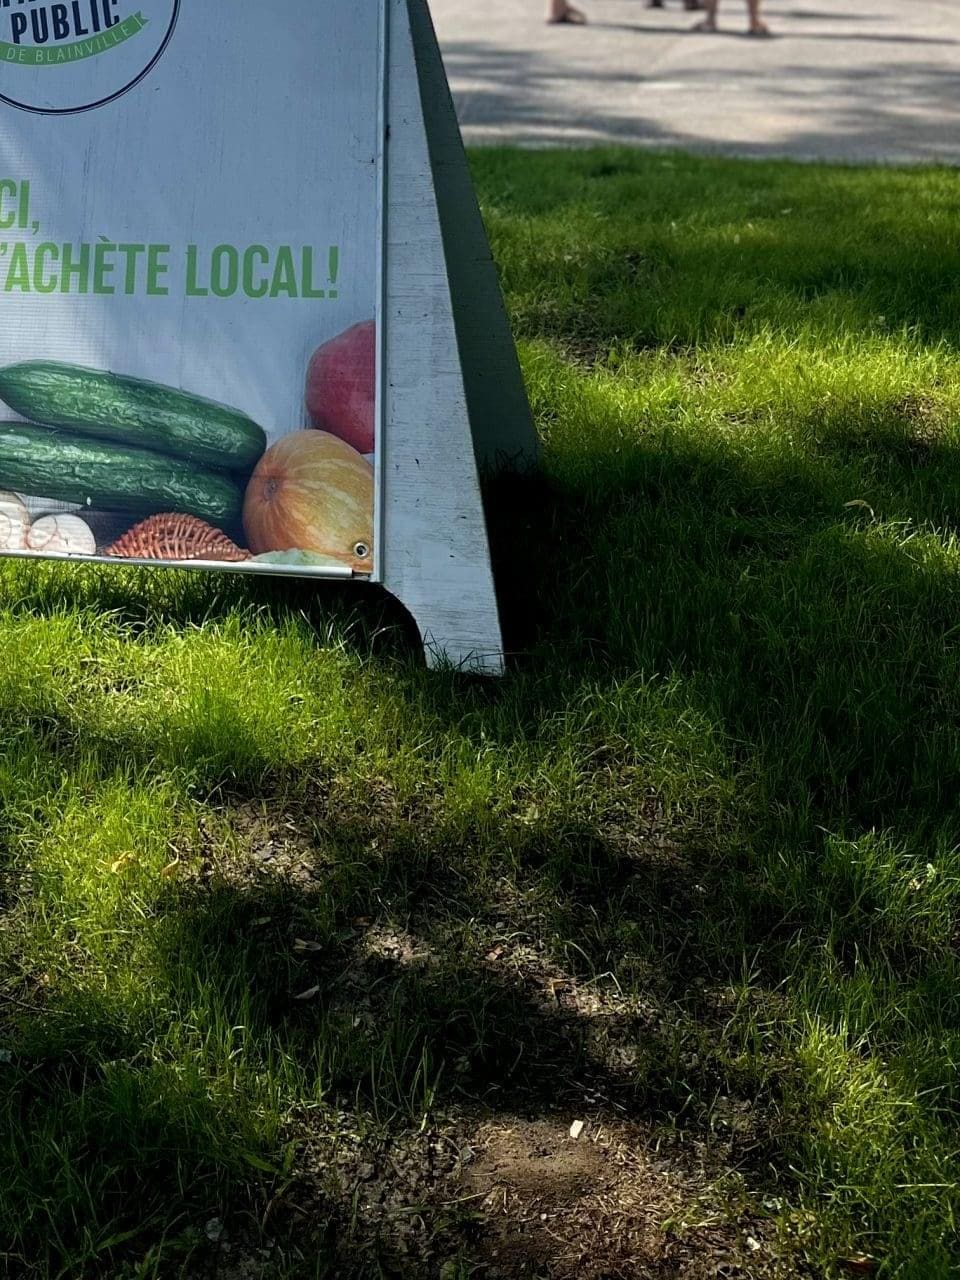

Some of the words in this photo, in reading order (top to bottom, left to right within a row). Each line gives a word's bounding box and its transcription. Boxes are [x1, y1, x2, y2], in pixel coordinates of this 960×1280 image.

[6, 48, 25, 62] DE
[35, 26, 130, 62] BLAINVILLE
[185, 243, 339, 299] LOCAL!
